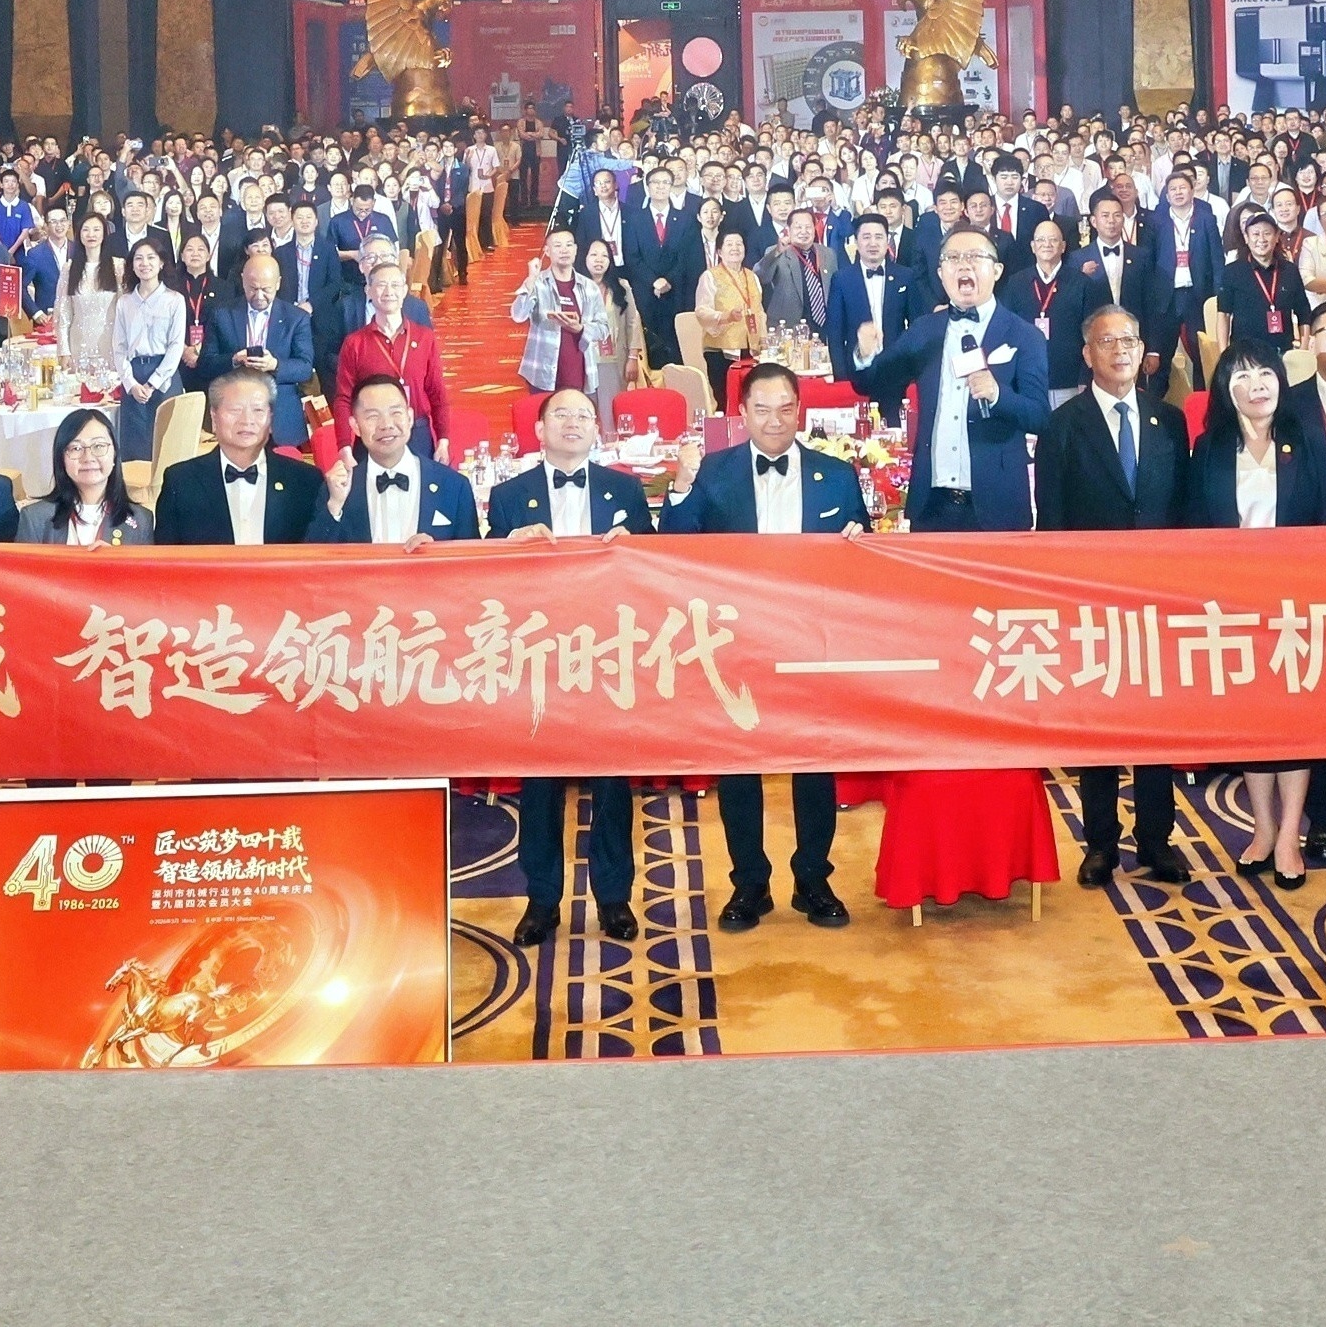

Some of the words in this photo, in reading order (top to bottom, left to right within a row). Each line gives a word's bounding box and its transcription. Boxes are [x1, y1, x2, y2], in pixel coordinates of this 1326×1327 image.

[52, 597, 760, 739] 智造领航新时代
[153, 825, 305, 857] 匠心筑梦四十载
[154, 855, 312, 886] 智造领航新时代
[150, 896, 253, 910] 暨九届四次会员大会
[151, 884, 313, 899] 深圳市机械行业协会40周年庆典
[58, 898, 120, 911] 1986-2026
